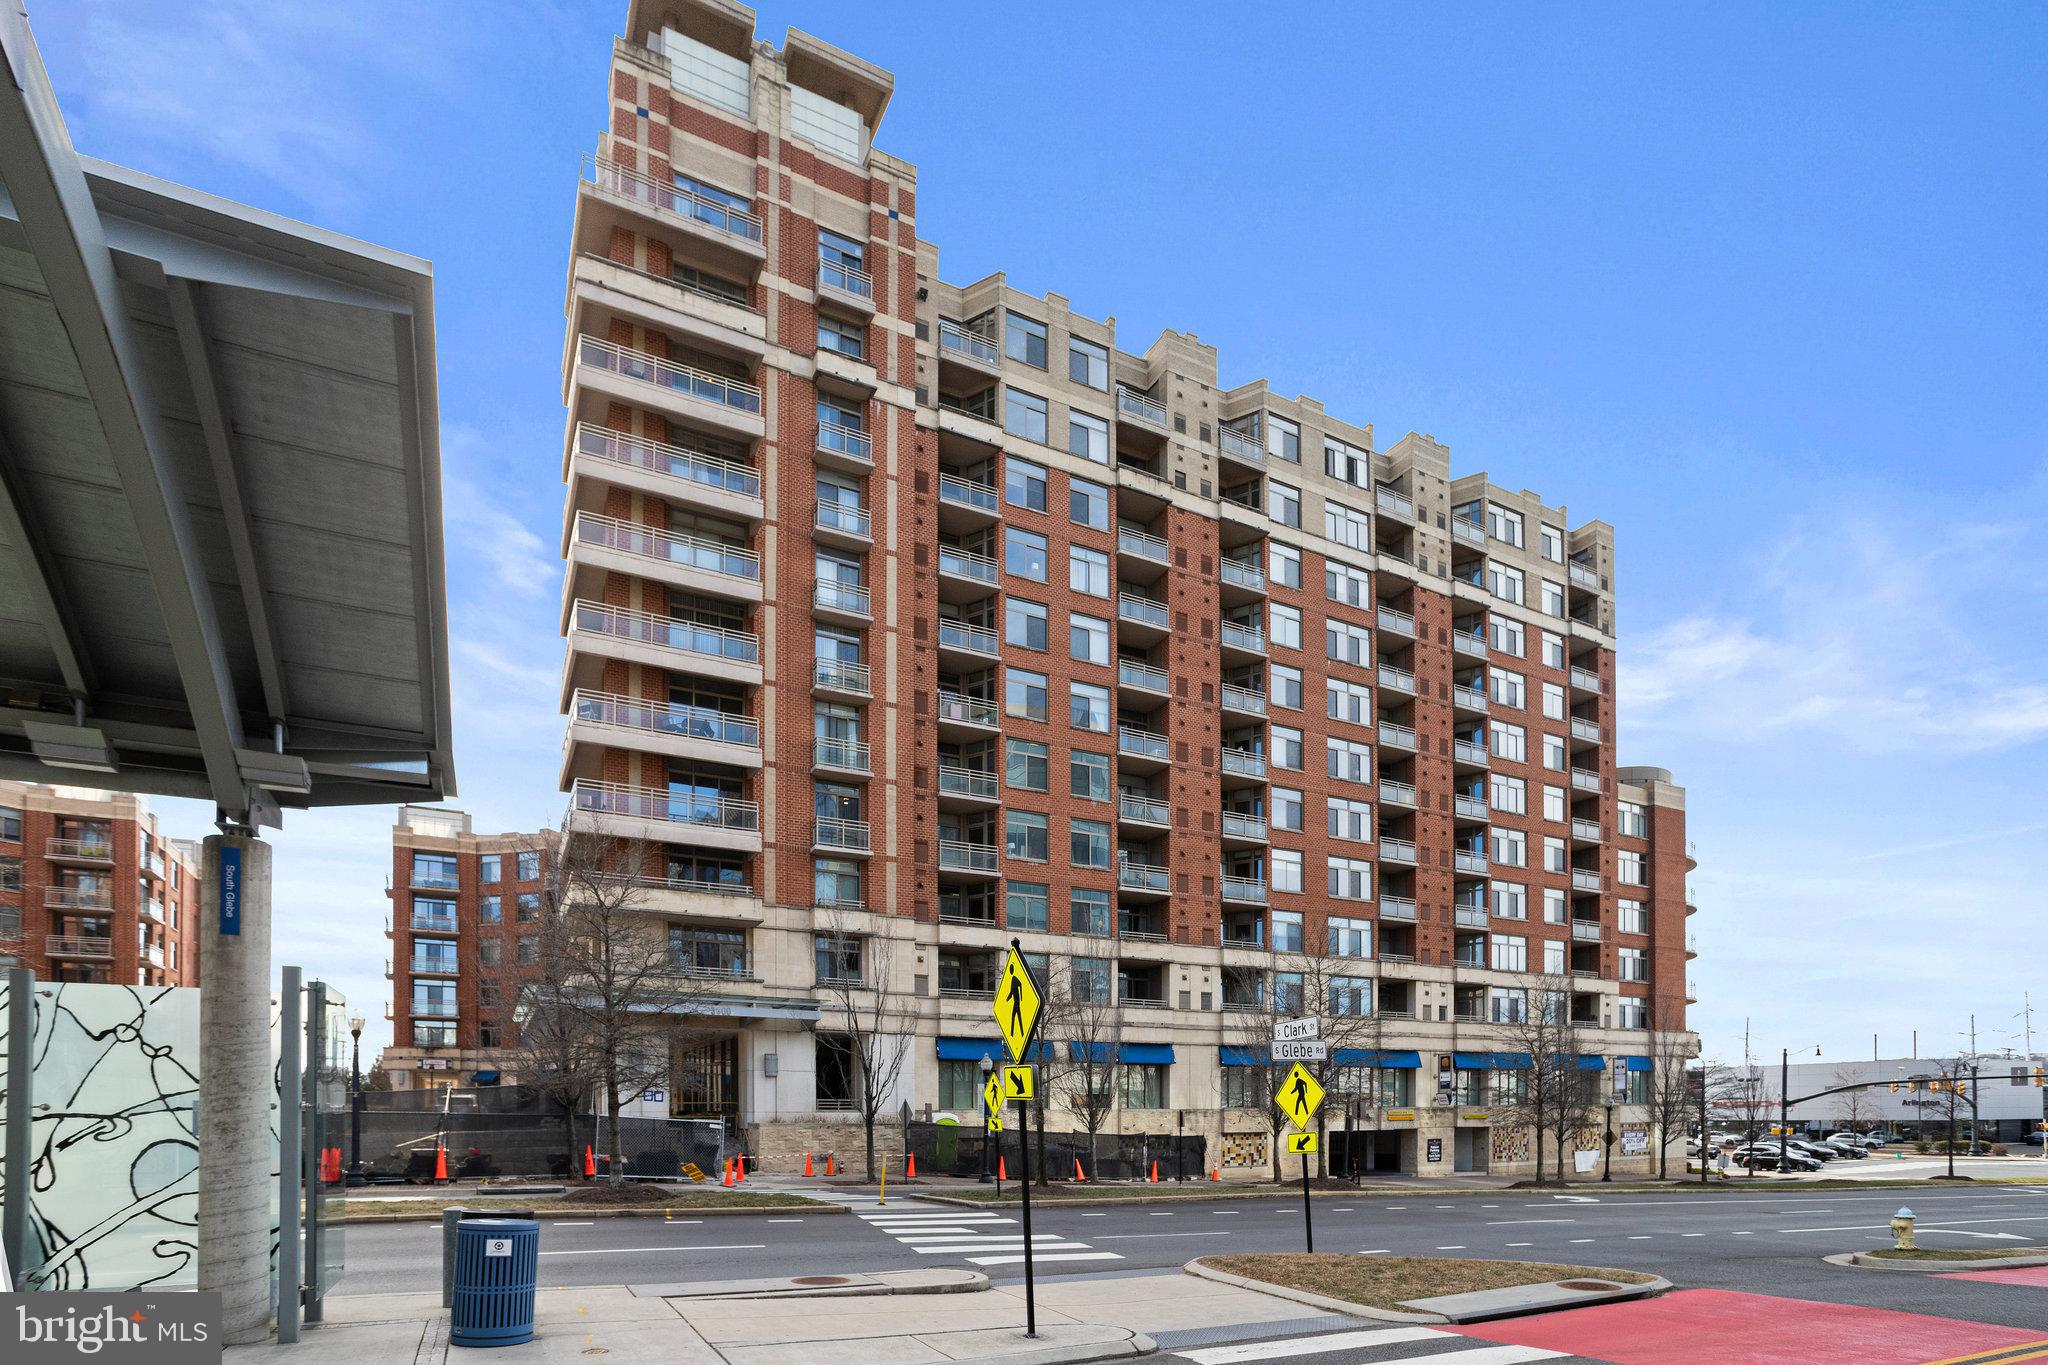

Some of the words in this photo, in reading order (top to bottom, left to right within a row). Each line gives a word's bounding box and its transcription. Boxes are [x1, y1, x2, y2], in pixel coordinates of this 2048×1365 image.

[225, 864, 235, 890] South
[225, 892, 235, 918] Glebe
[1284, 1022, 1307, 1038] Clark
[1282, 1044, 1313, 1057] Glebe
